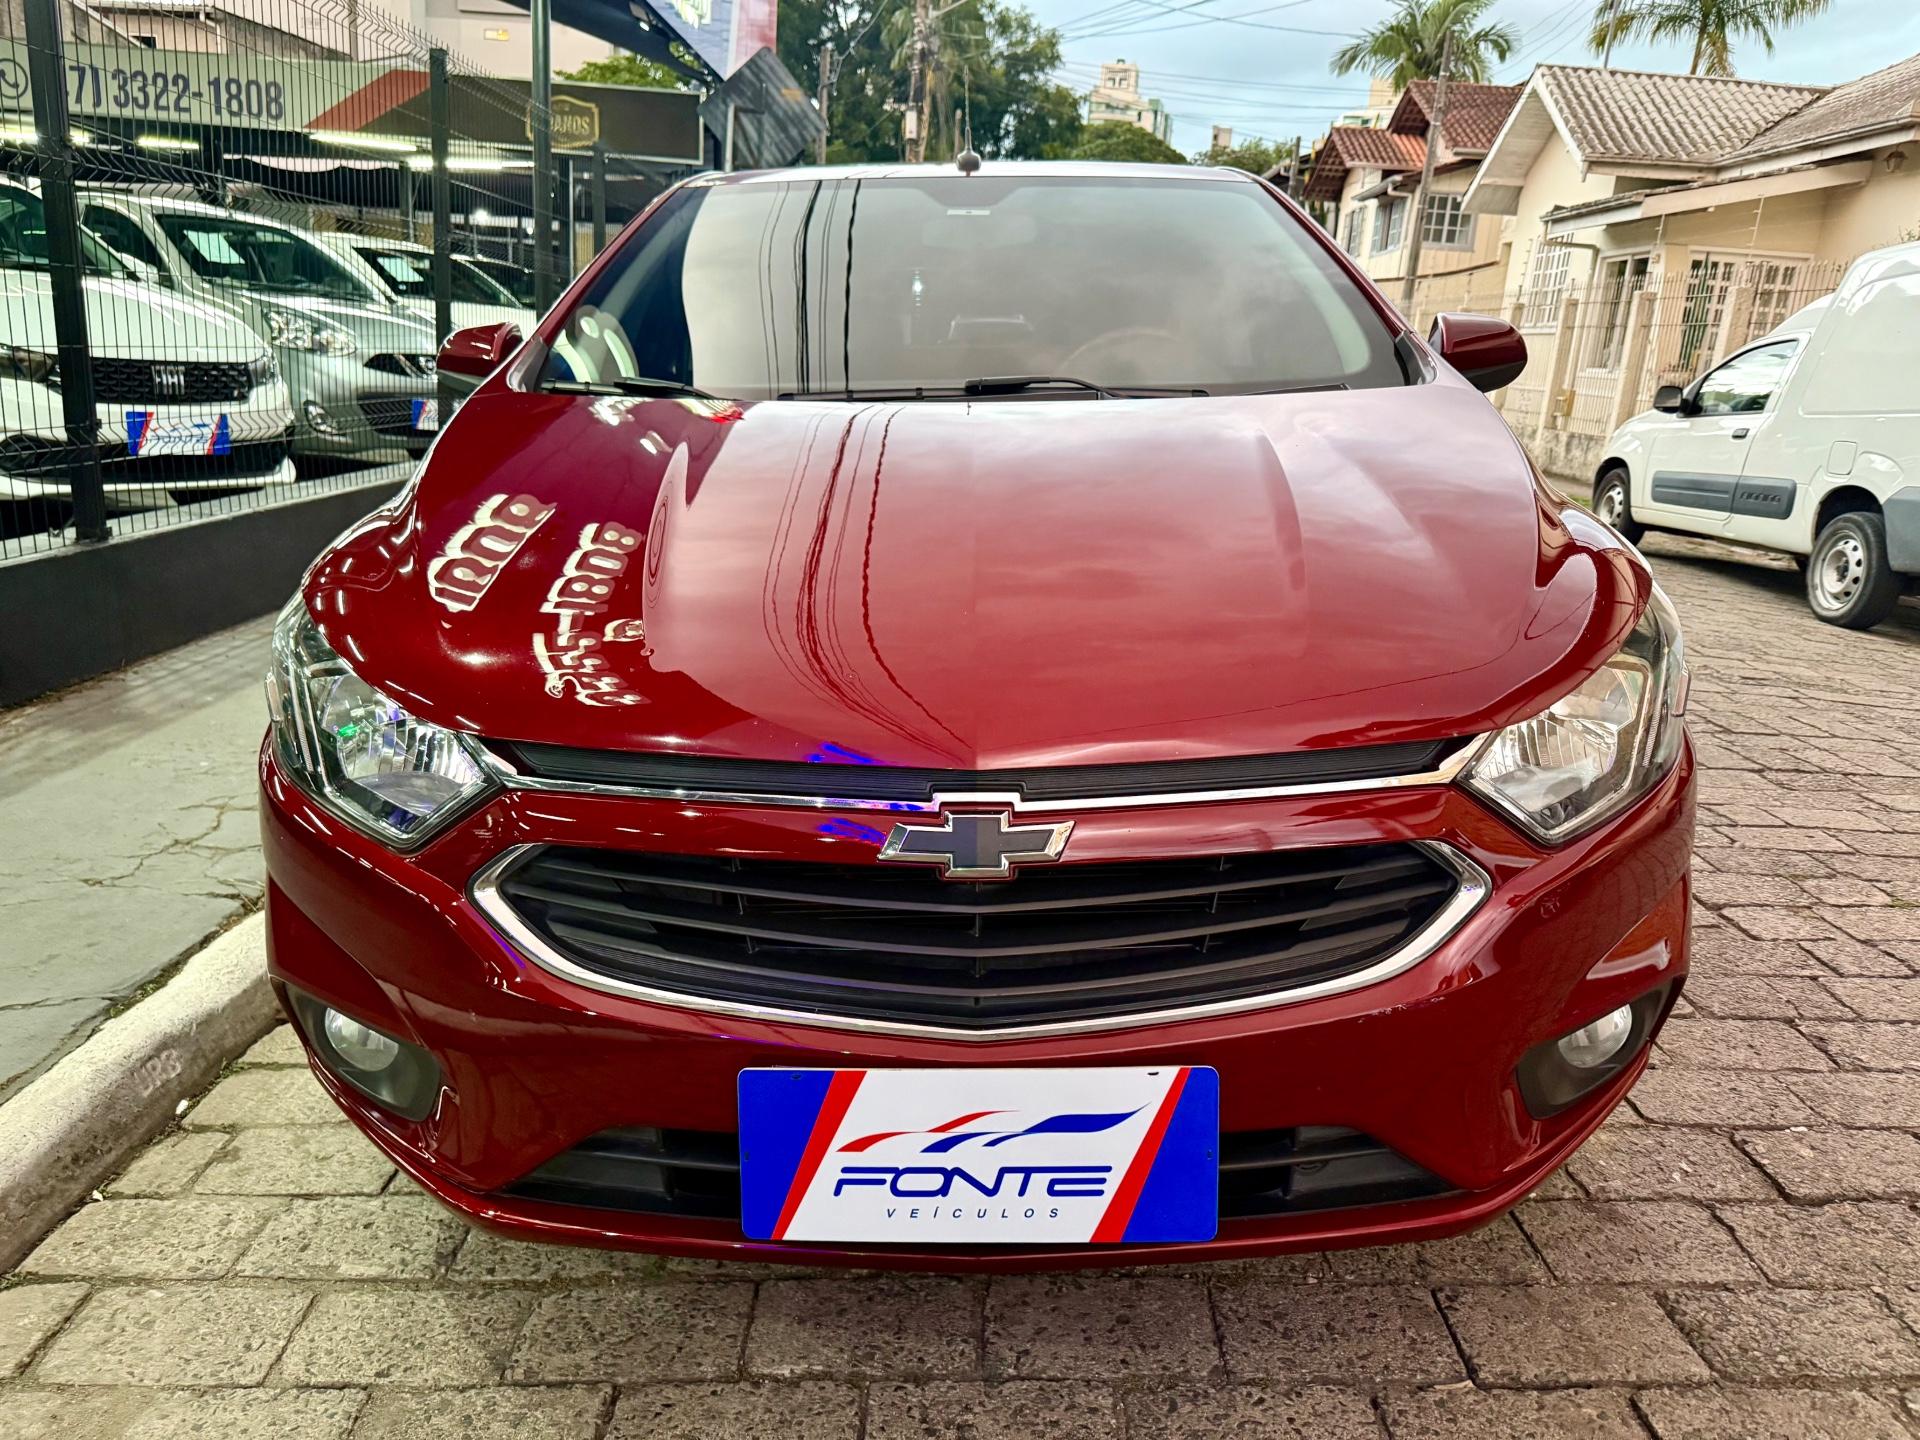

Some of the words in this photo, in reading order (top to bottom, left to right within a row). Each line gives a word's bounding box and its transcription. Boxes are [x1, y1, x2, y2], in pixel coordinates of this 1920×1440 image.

[111, 68, 284, 121] 3322-1808
[833, 1165, 1113, 1198] FONTE
[886, 1206, 1060, 1219] VEÍCULOS
